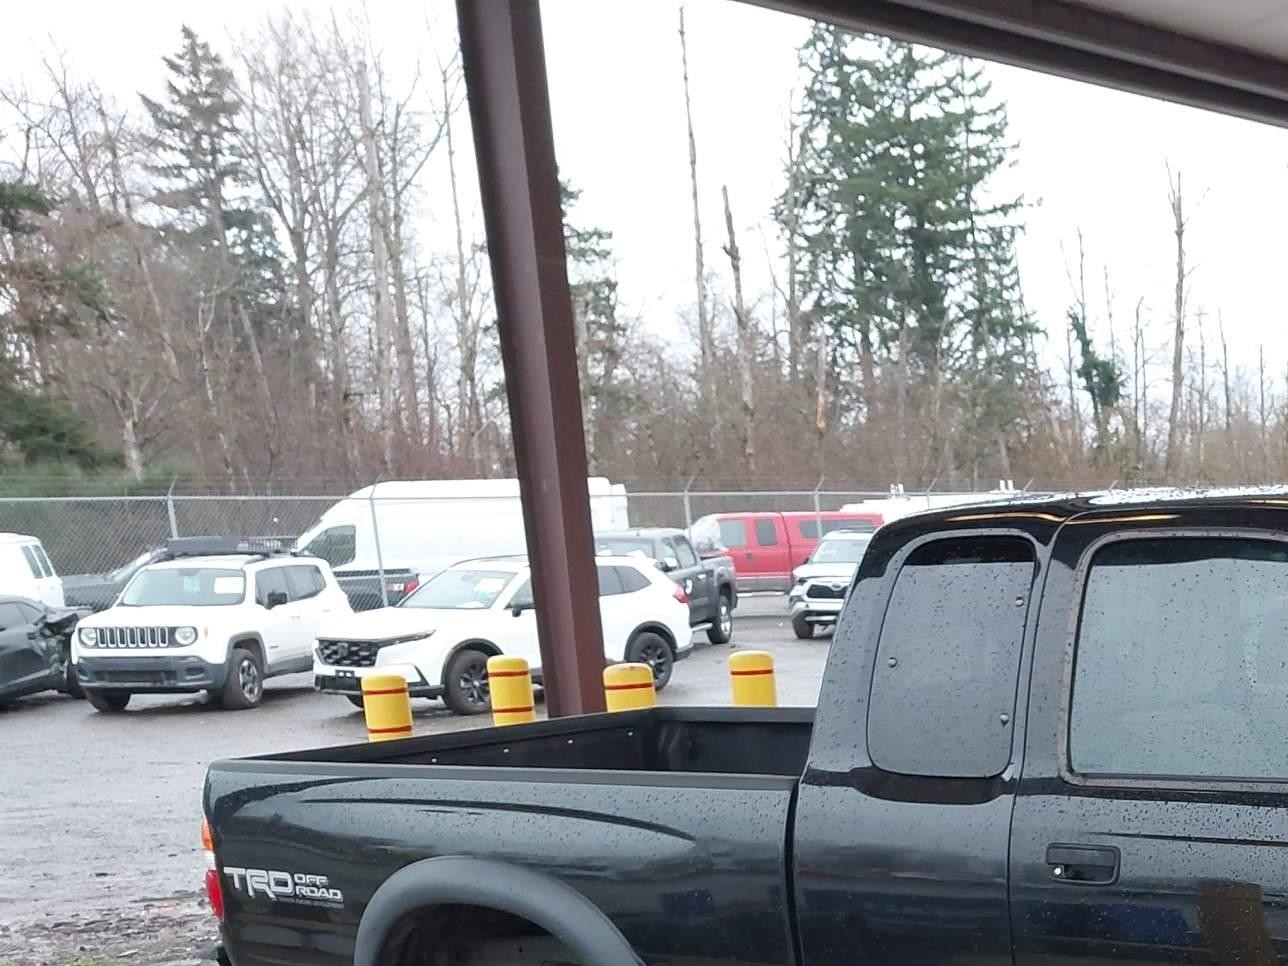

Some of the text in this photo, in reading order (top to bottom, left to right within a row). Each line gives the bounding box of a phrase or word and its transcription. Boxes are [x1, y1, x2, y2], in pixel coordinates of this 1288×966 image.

[223, 866, 294, 902] TRD
[294, 873, 329, 886] OFF
[295, 886, 343, 902] ROAD
